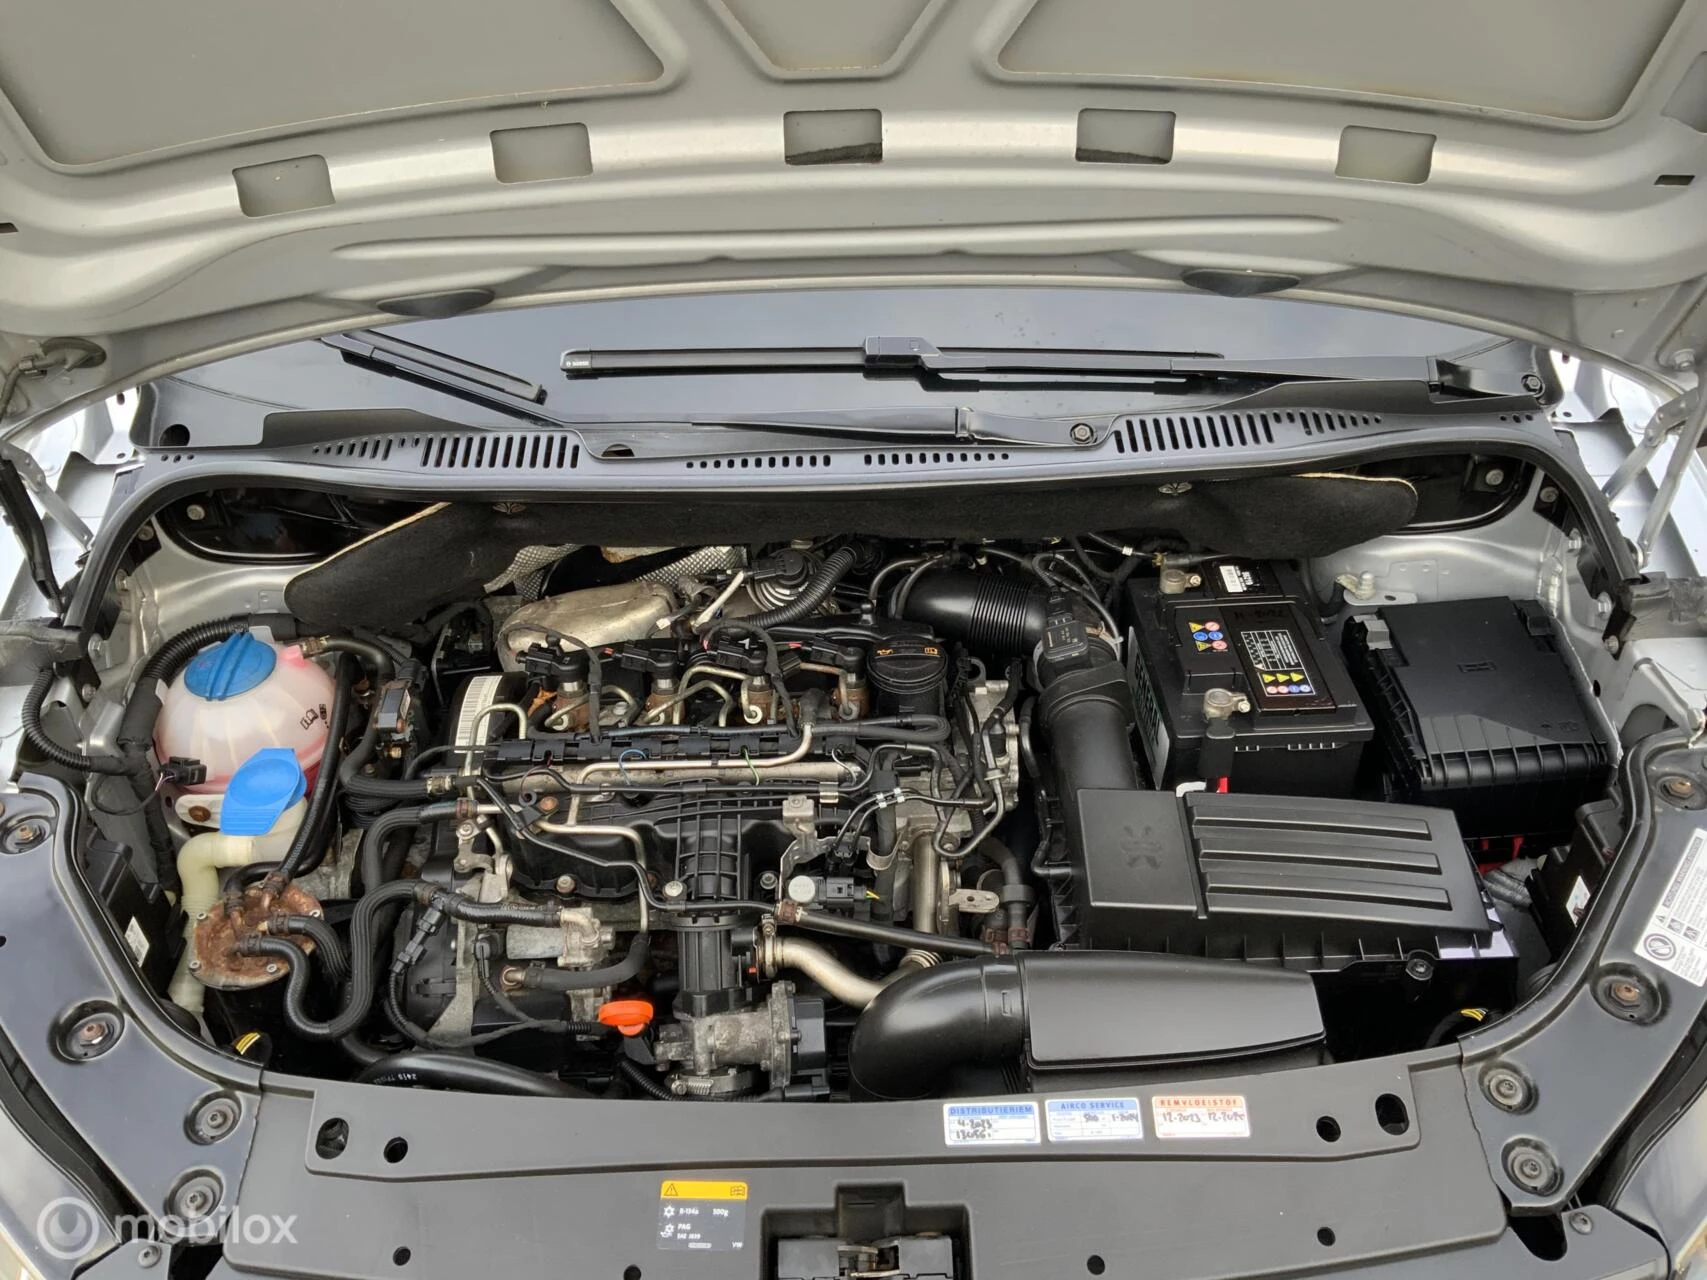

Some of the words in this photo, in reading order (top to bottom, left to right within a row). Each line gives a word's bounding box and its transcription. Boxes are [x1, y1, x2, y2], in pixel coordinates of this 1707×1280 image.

[1061, 1102, 1087, 1110] AIRCO
[1090, 1101, 1124, 1109] SERVICE
[950, 1106, 1032, 1115] DISTRIBUTIERIEM
